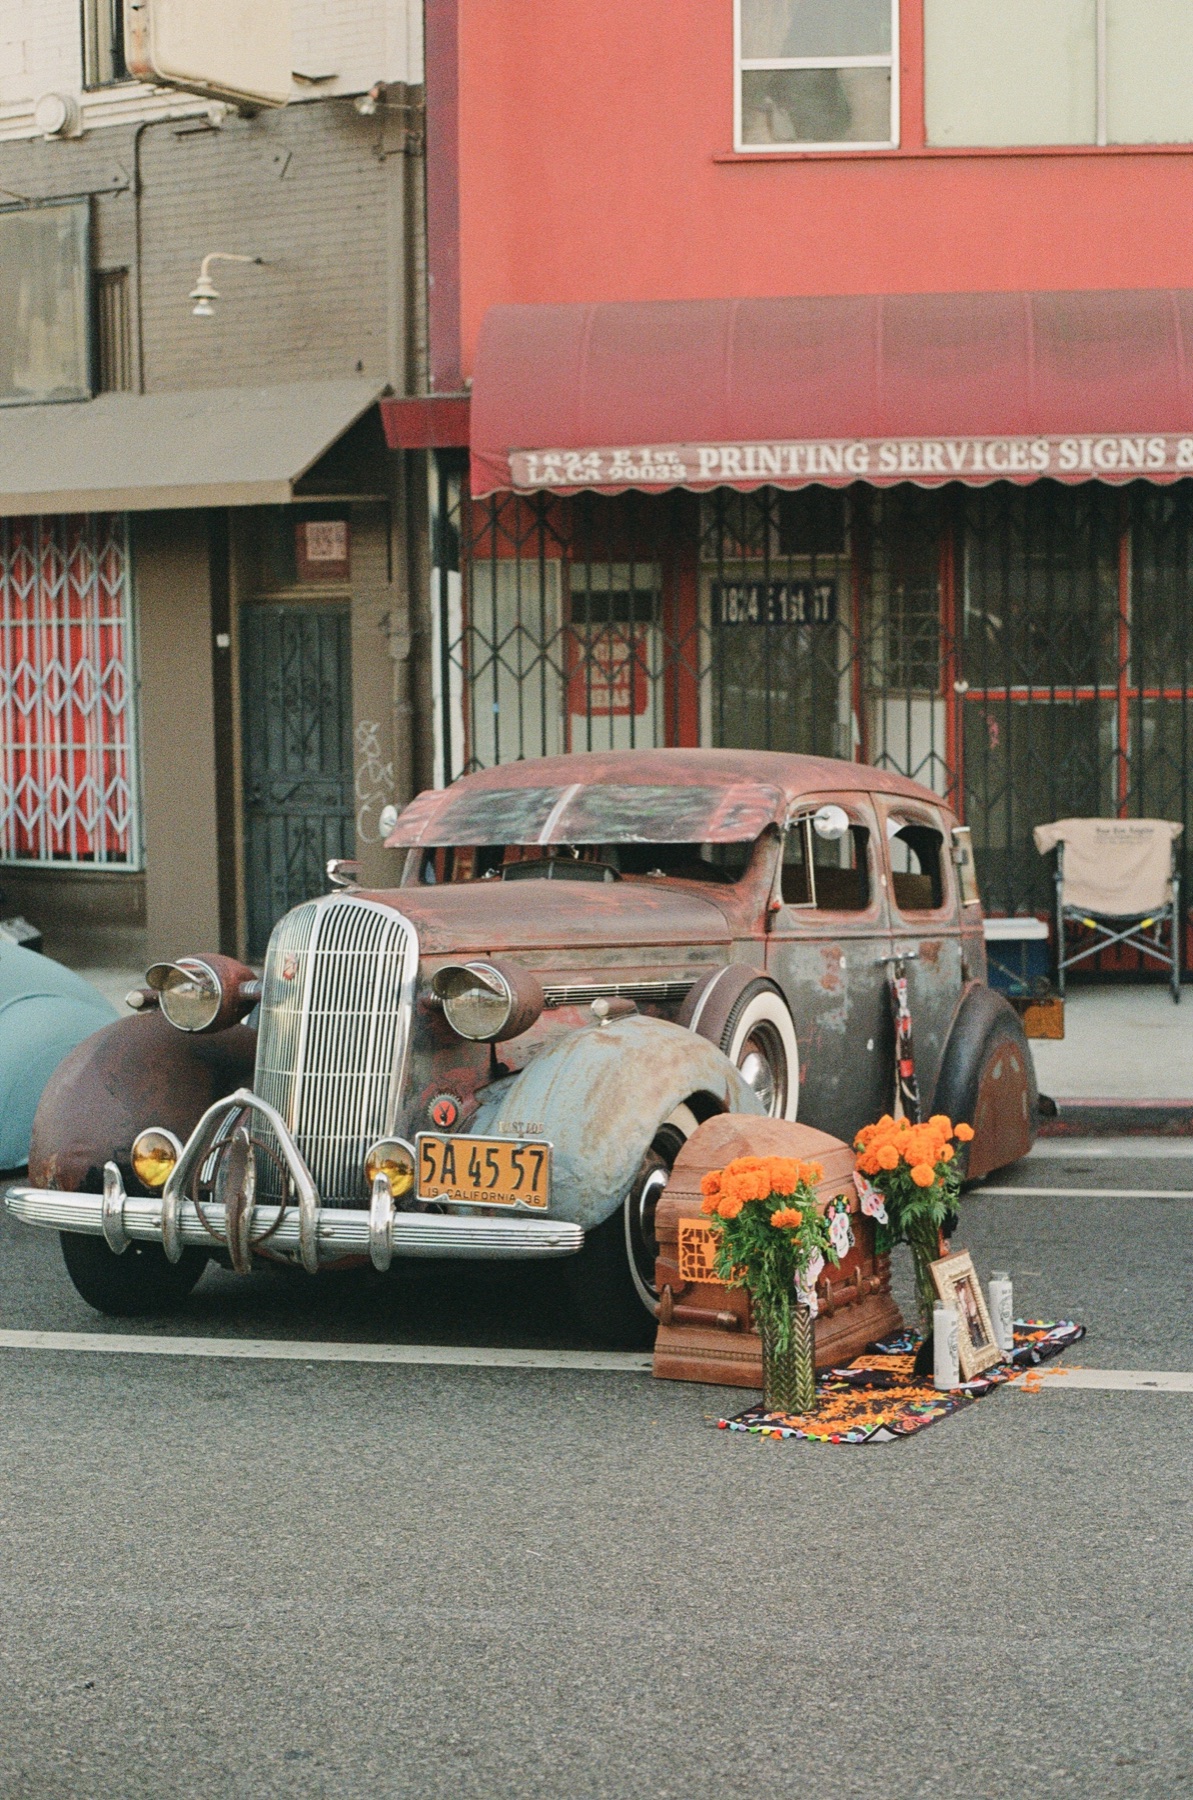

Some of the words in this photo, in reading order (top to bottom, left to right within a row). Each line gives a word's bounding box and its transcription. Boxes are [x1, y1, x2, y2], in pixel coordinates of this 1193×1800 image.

[612, 450, 634, 466] E
[697, 444, 869, 477] PRINTING
[878, 440, 1050, 473] SERVICES
[1058, 437, 1167, 470] SIGNS
[1176, 438, 1193, 469] &
[608, 464, 688, 482] 90033
[422, 1142, 457, 1185] 5A
[468, 1146, 499, 1188] 45
[511, 1149, 544, 1192] 57
[427, 1187, 439, 1197] 19
[446, 1188, 516, 1202] CALIFORNIA
[525, 1194, 541, 1205] 36
